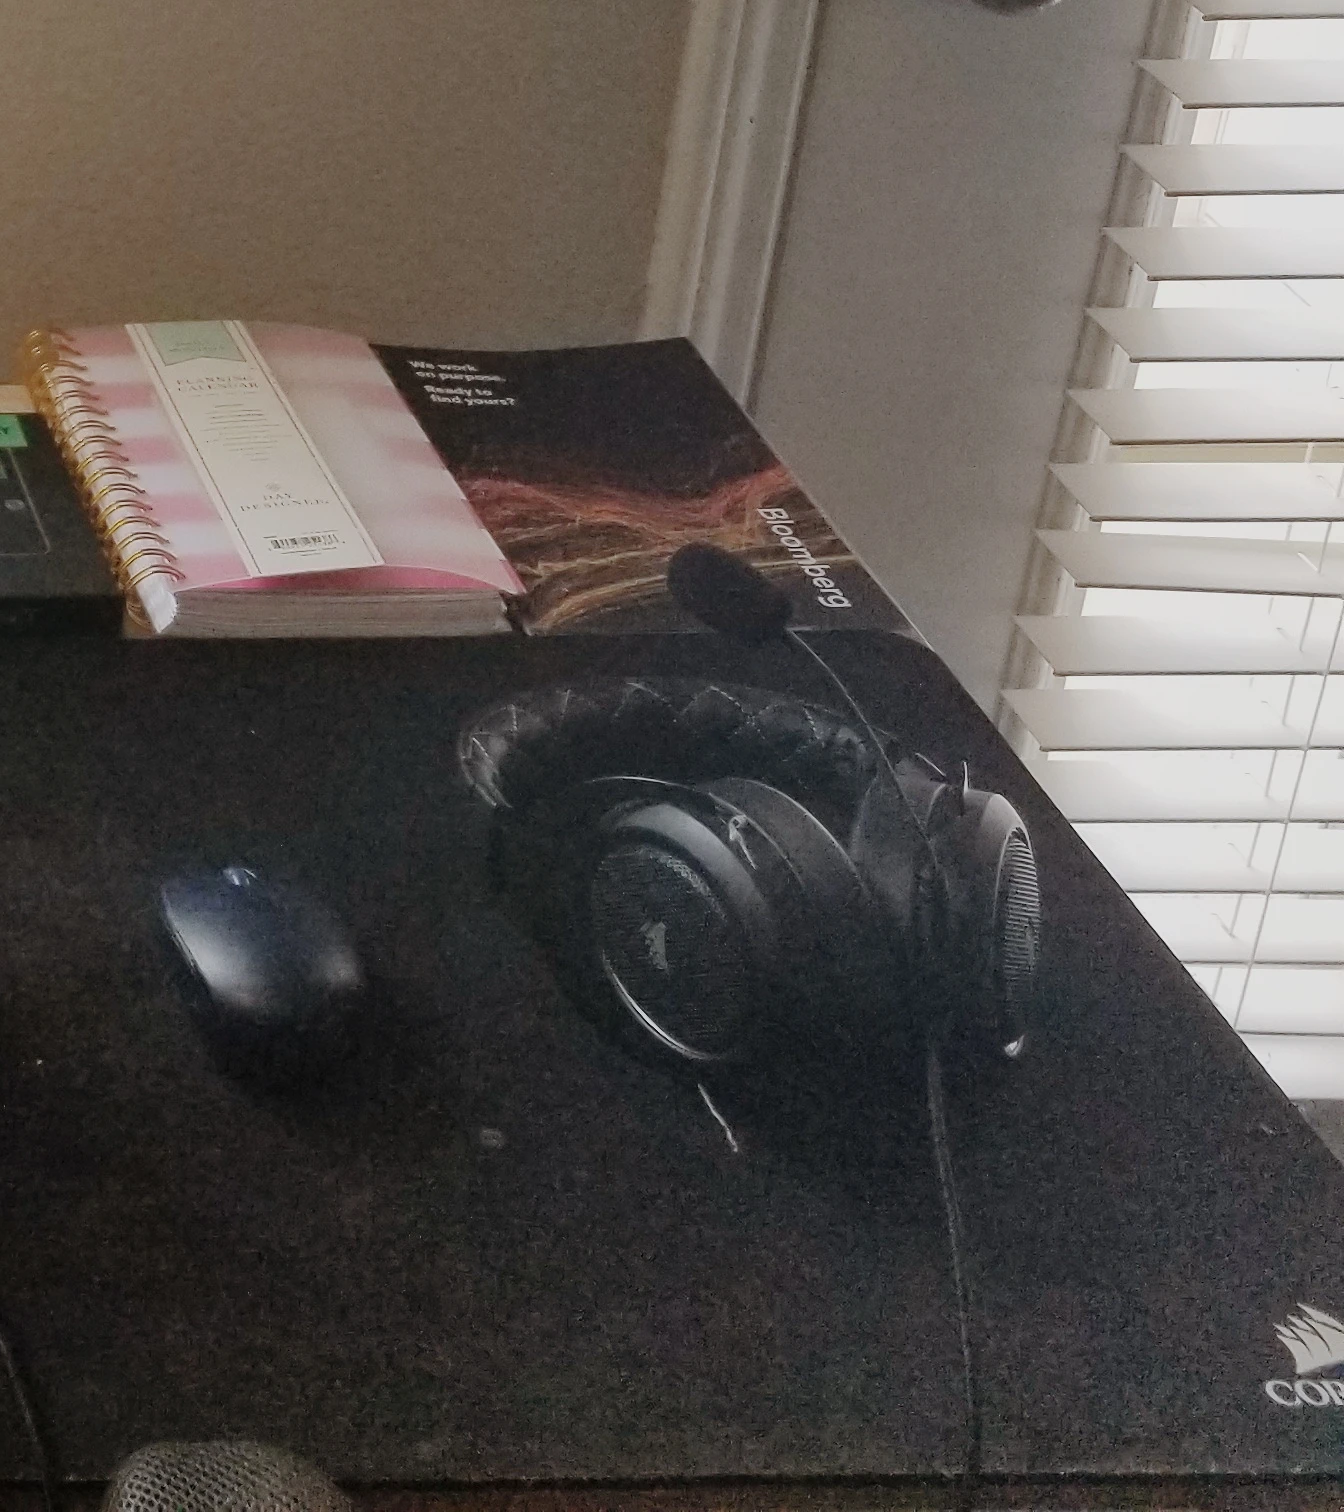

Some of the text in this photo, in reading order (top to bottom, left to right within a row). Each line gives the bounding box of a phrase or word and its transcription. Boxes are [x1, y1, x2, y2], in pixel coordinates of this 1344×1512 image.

[408, 360, 478, 372] We work
[423, 385, 493, 397] Ready to
[430, 393, 515, 406] find yours?
[756, 508, 852, 608] Bloomberg
